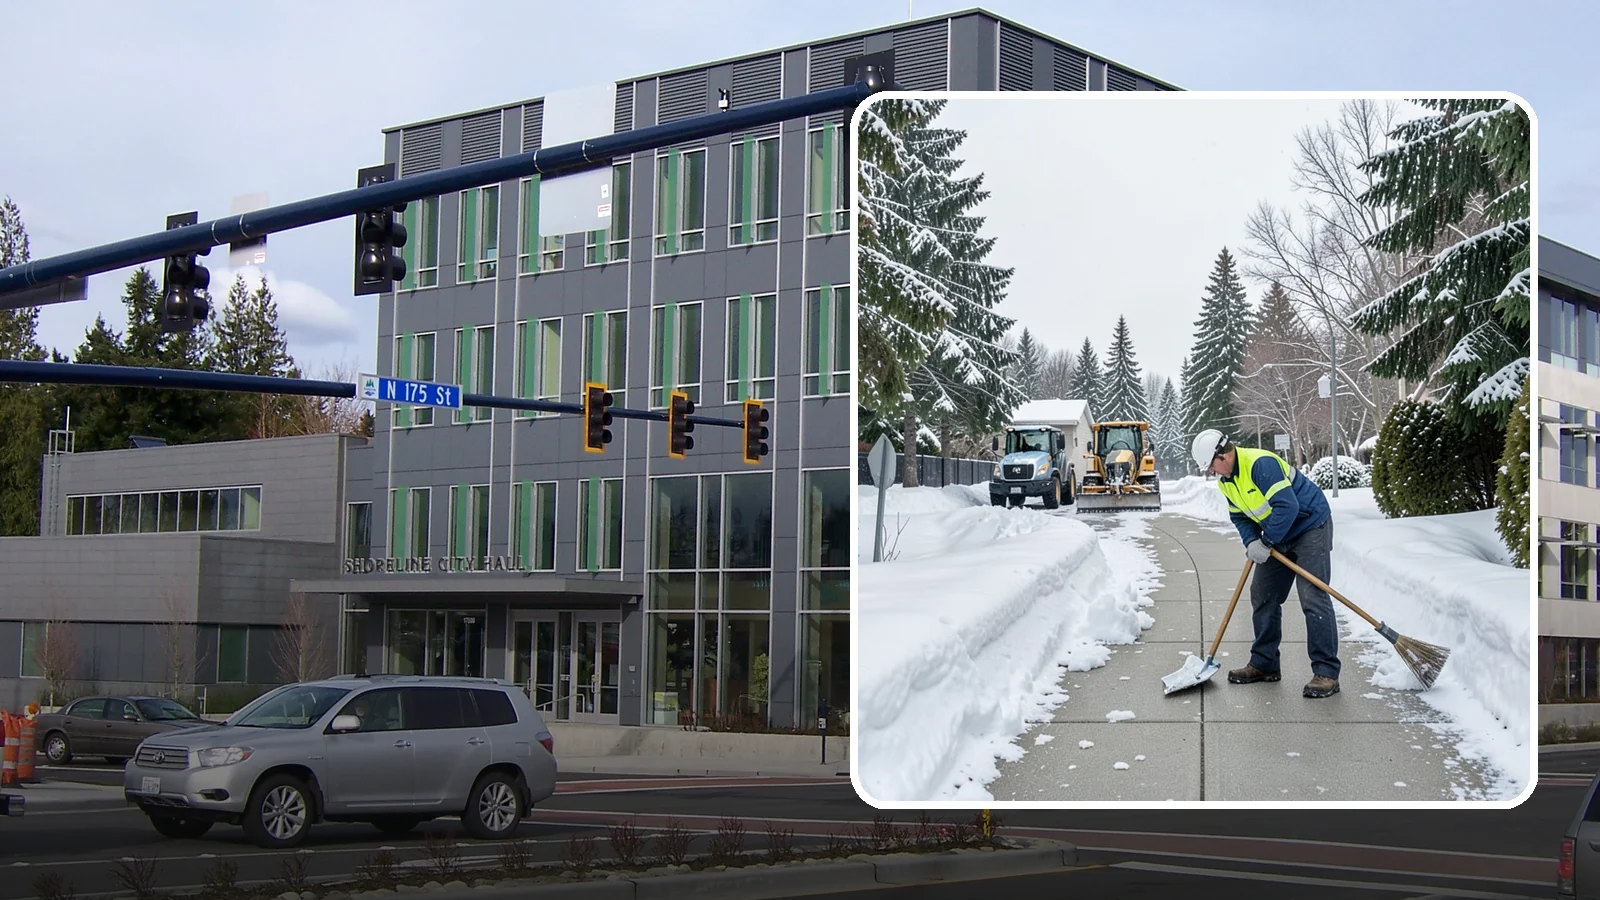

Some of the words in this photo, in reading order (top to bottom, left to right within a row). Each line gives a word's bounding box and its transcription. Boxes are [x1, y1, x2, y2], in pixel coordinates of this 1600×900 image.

[387, 380, 396, 399] N
[405, 382, 427, 403] 175
[436, 386, 451, 406] St
[343, 557, 431, 573] SHORELINE
[439, 556, 475, 572] CITY
[483, 556, 525, 571] HALL
